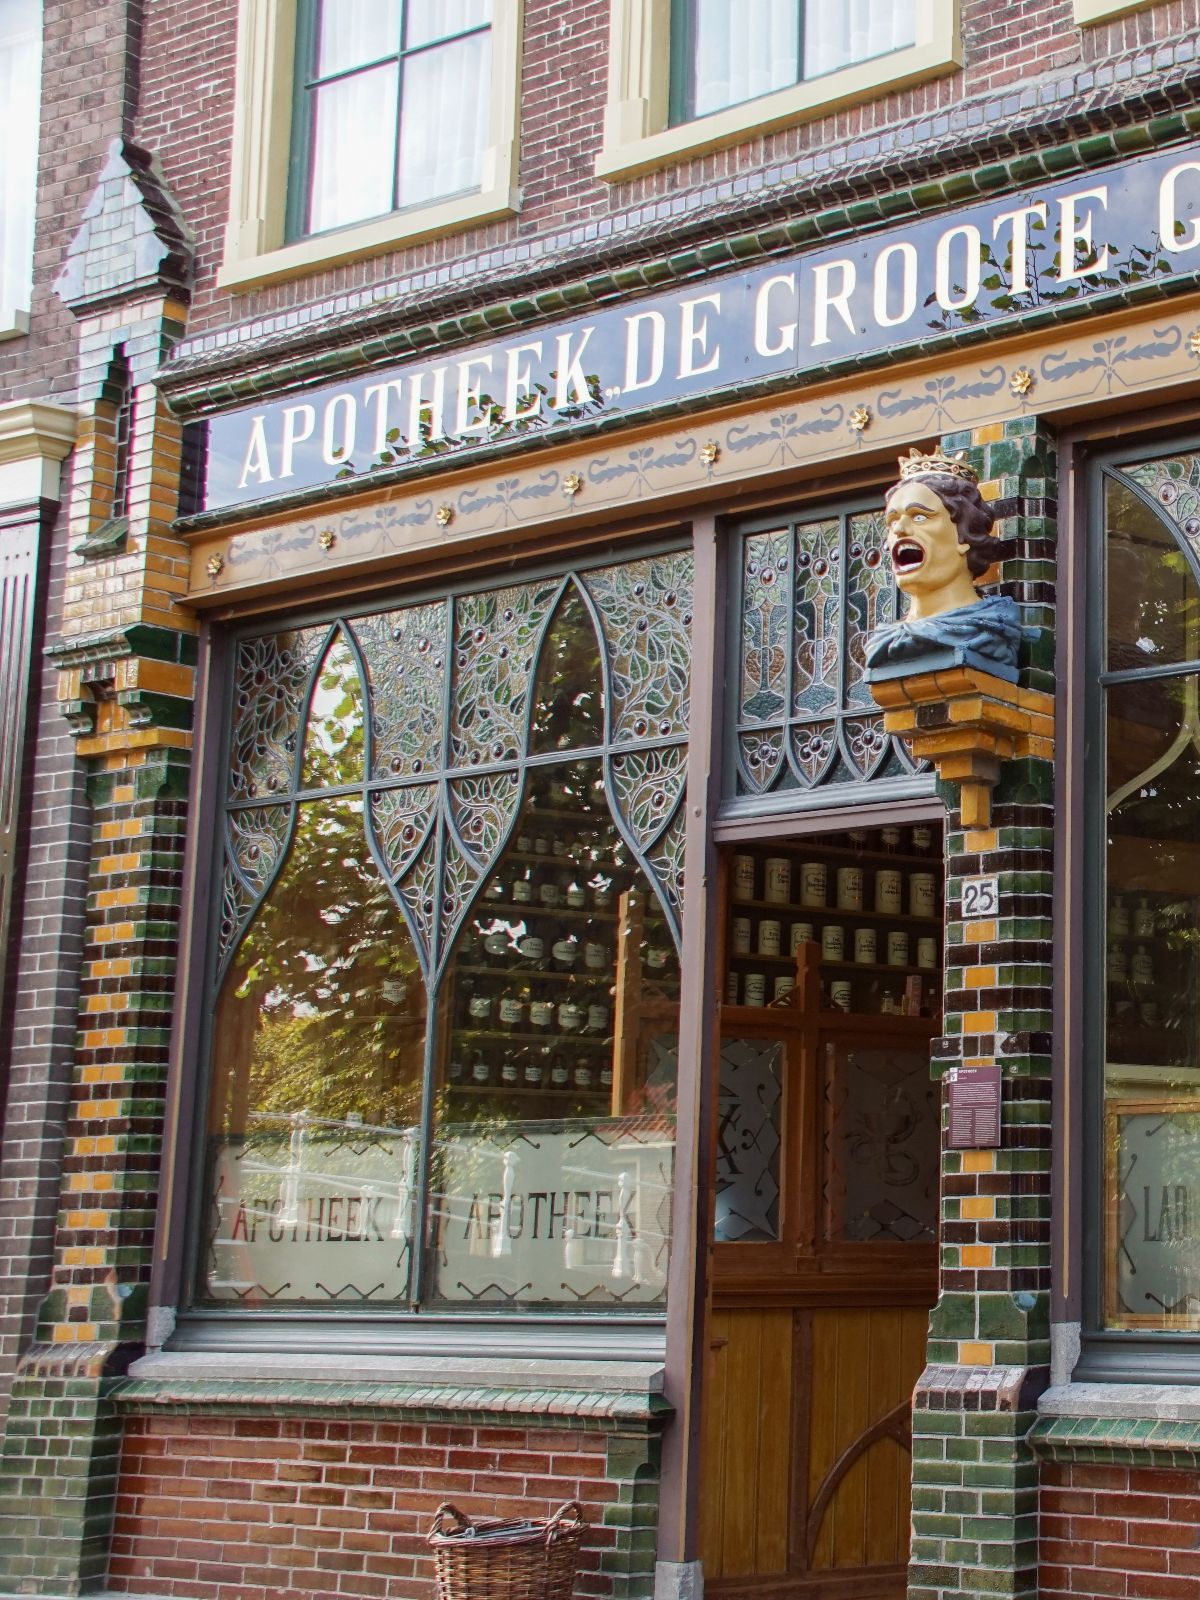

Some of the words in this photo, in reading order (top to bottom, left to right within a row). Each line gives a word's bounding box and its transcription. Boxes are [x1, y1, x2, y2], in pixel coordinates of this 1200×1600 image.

[237, 326, 596, 489] APOTHEEK
[754, 186, 1108, 358] GROOTE
[964, 882, 994, 914] 25
